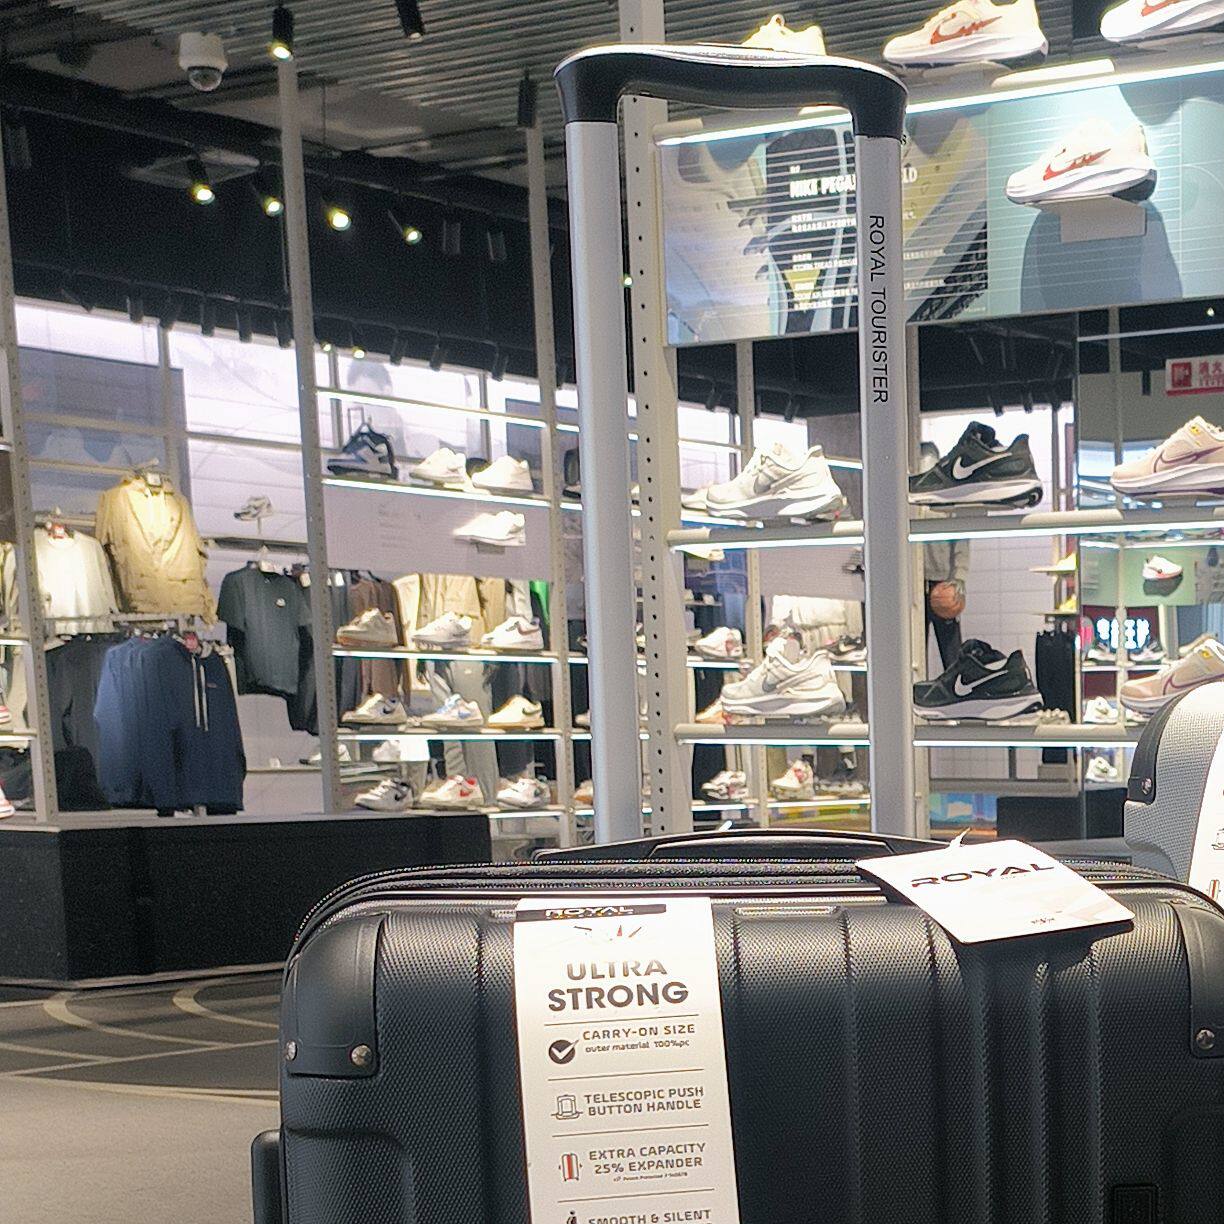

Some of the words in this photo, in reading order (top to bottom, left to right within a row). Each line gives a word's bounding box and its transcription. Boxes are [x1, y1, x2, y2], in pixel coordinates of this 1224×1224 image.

[869, 215, 885, 282] ROYAL
[871, 288, 888, 403] TOURISTER
[911, 863, 1055, 888] ROYAL
[566, 959, 667, 981] ULTRA
[548, 981, 689, 1012] STRONG
[582, 1027, 659, 1041] CARRY-ON
[664, 1024, 695, 1035] SIZE
[585, 1044, 610, 1053] outer
[612, 1041, 650, 1051] material
[584, 1089, 665, 1104] TELESCOPIC
[669, 1086, 704, 1098] PUSH
[588, 1103, 642, 1116] BUTTON
[647, 1099, 701, 1112] HANDLE
[589, 1148, 636, 1161] EXTRA
[640, 1142, 706, 1156] CAPACITY
[595, 1163, 624, 1174] 25%
[628, 1157, 703, 1172] EXPANDER
[651, 1213, 659, 1223] &
[664, 1209, 712, 1222] SILENT
